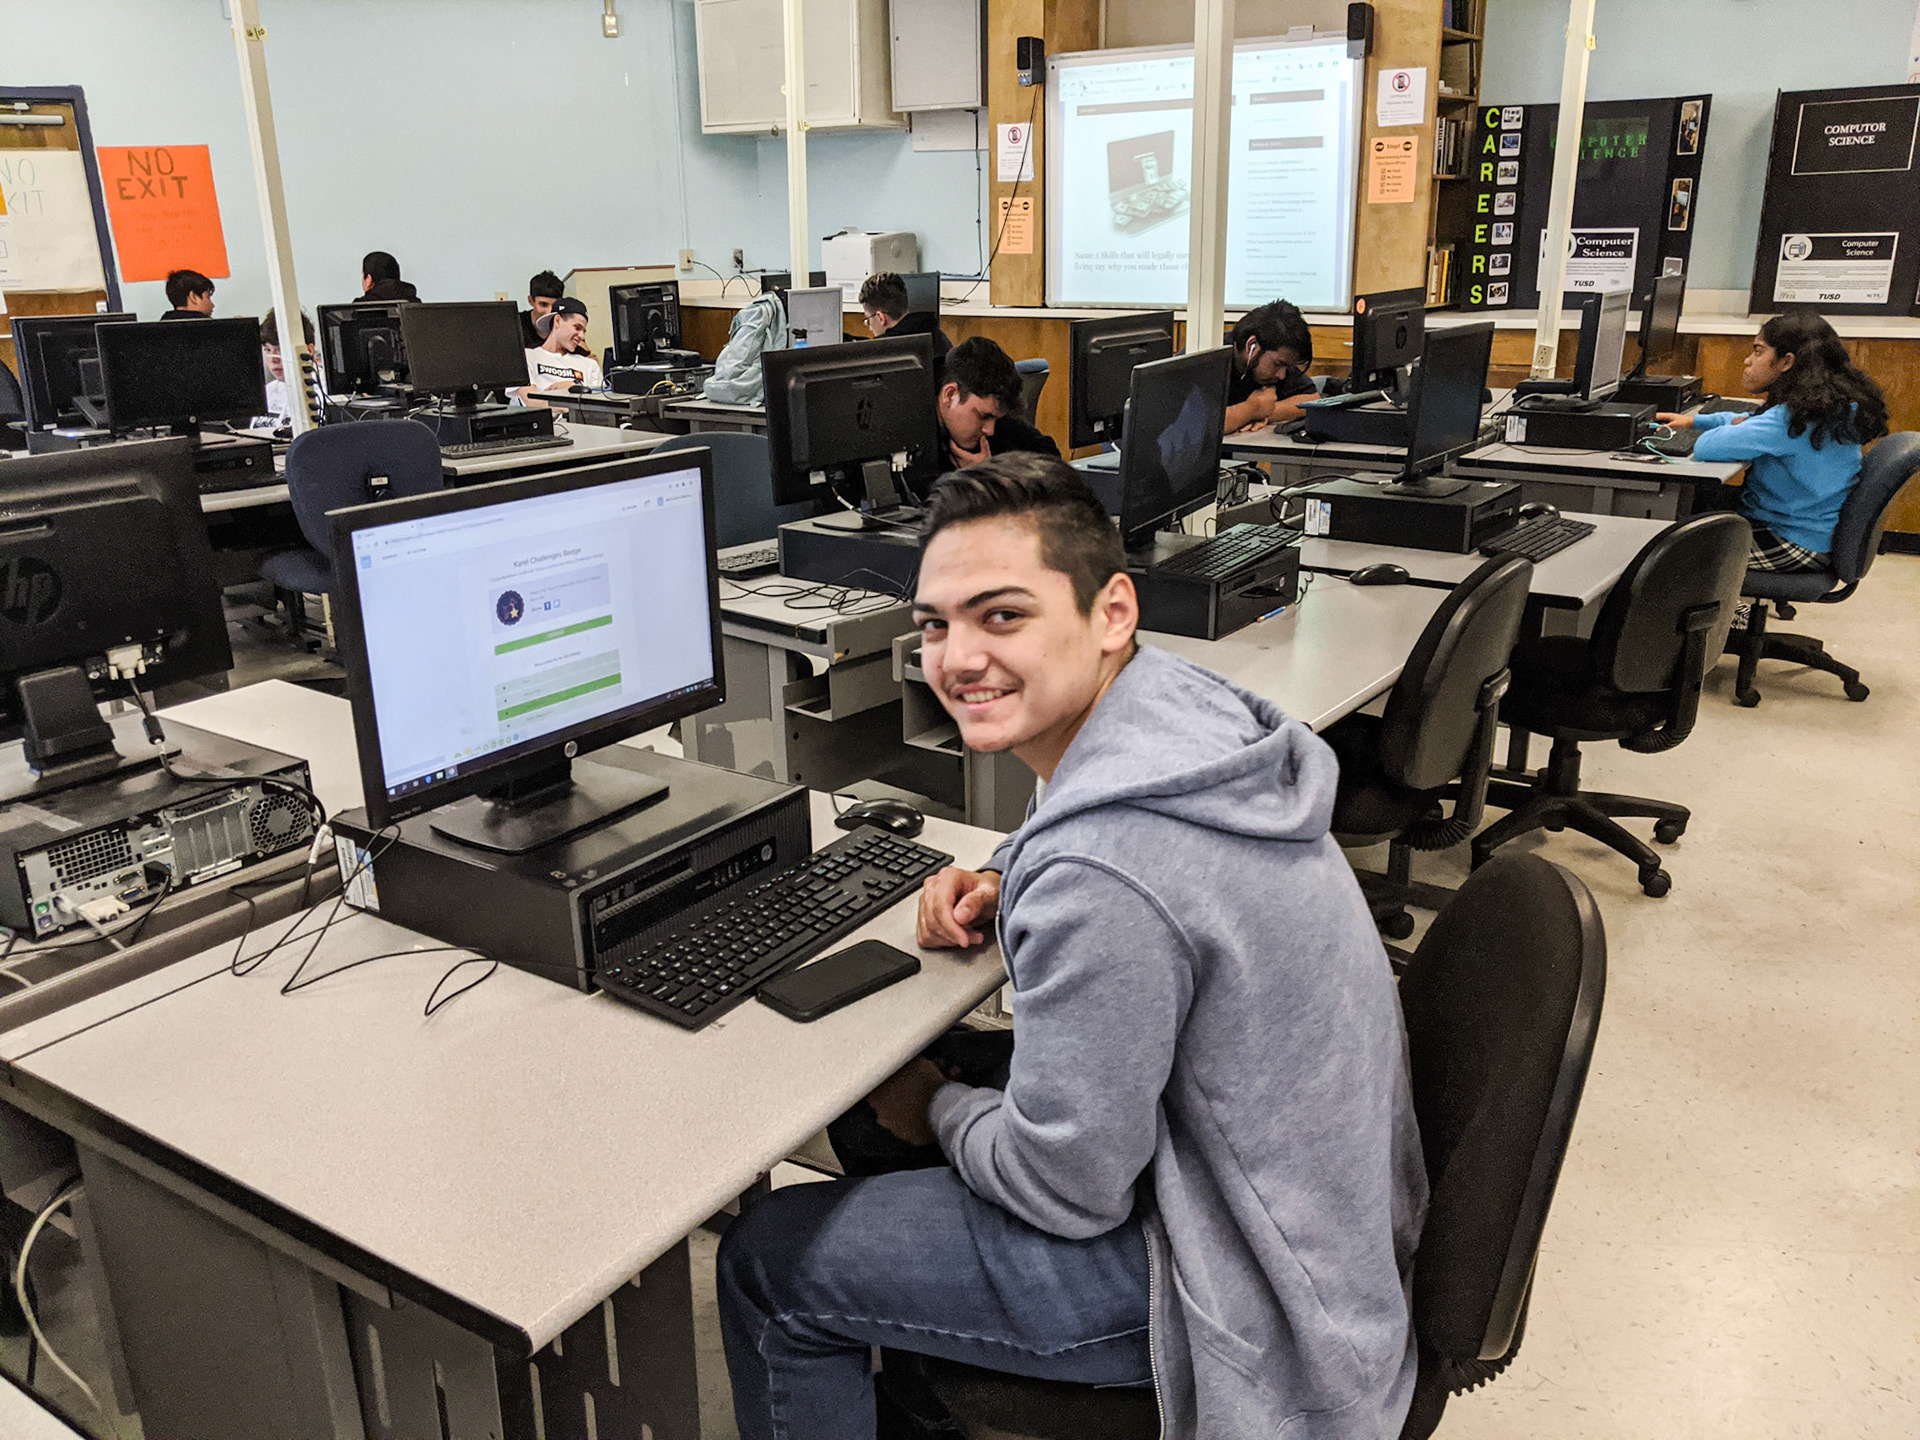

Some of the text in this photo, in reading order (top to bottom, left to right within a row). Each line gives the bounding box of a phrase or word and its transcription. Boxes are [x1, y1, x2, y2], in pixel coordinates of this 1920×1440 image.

[1824, 122, 1886, 134] COMPUTOR
[1828, 135, 1875, 146] SCIENCE
[127, 147, 174, 177] NO
[117, 175, 188, 200] EXIT
[1469, 107, 1501, 305] CAREERS
[1577, 236, 1633, 247] Computer
[1841, 240, 1879, 248] Computer
[1101, 250, 1119, 260] Skills
[1121, 250, 1135, 260] that
[1136, 250, 1150, 260] will
[1151, 250, 1174, 261] legally
[1582, 248, 1625, 257] Science
[1846, 248, 1874, 256] Science
[1074, 261, 1094, 272] living
[1107, 261, 1124, 272] why
[1124, 263, 1137, 272] you
[1138, 261, 1159, 271] made
[513, 558, 529, 568] Karel
